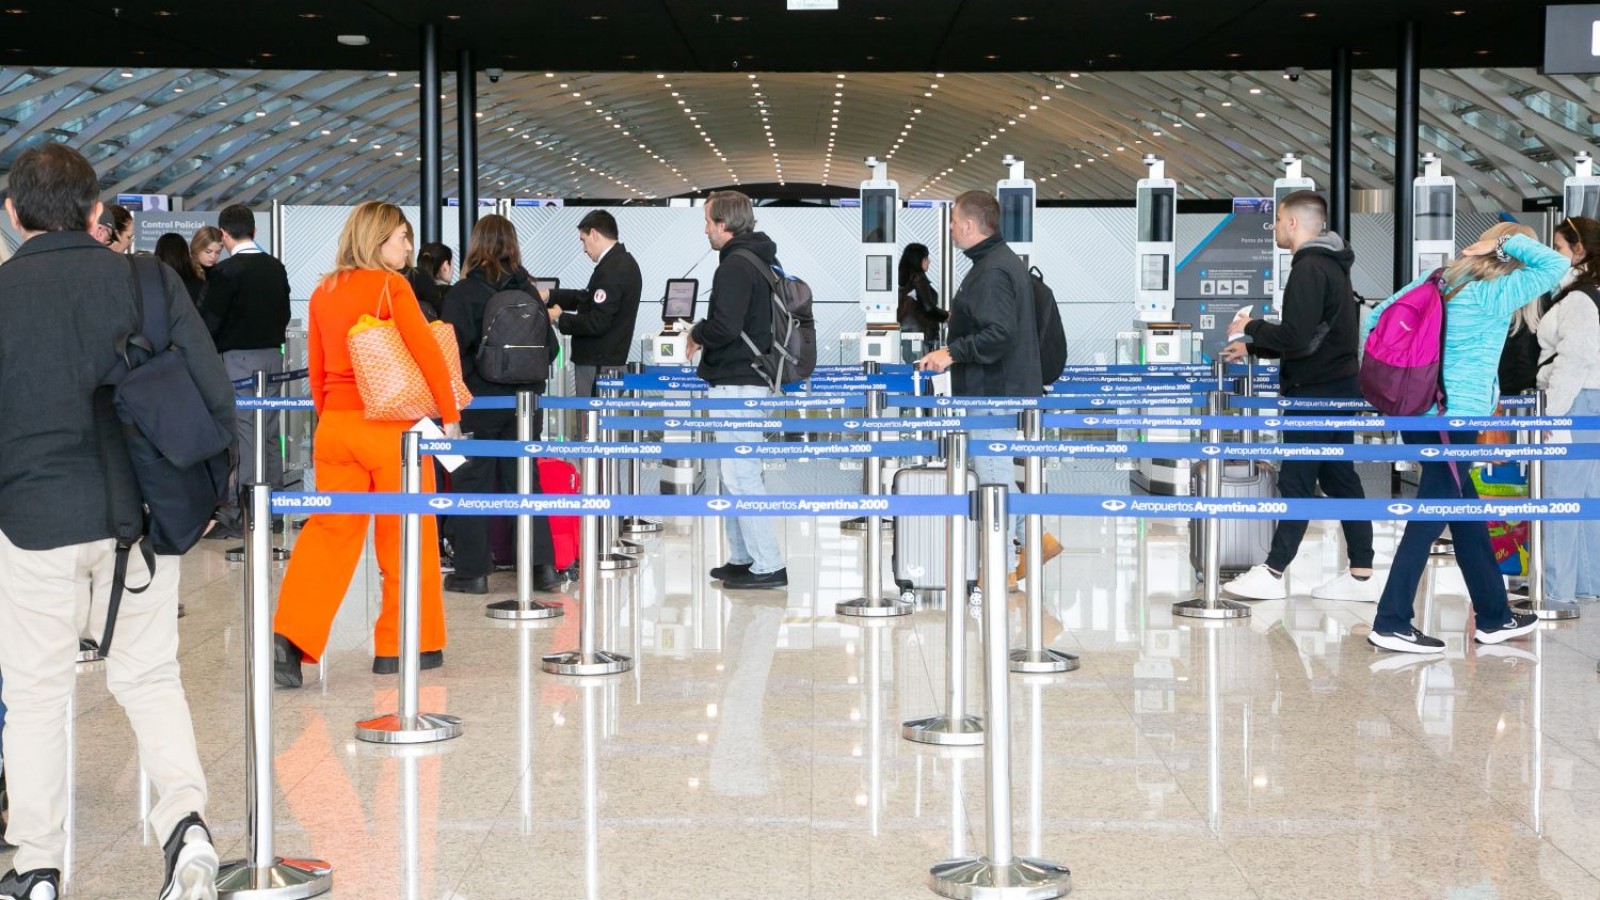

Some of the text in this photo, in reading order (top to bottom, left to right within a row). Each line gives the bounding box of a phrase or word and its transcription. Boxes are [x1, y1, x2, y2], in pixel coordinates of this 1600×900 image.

[141, 221, 206, 229] Control Policial
[262, 399, 297, 407] Argentina
[605, 400, 640, 408] Aeropuertos
[640, 400, 674, 408] Argentina
[760, 400, 794, 408] Aeropuertos
[794, 399, 828, 407] Argentina
[987, 399, 1021, 407] Argentina
[1329, 400, 1364, 408] Argentina
[683, 420, 782, 428] Aeropuertos Argentina 2000
[902, 420, 941, 428] Argentina
[942, 419, 960, 427] 2000
[1102, 418, 1202, 427] Aeropuertos Argentina 2000
[1283, 419, 1325, 427] Aeropuertos
[1325, 419, 1364, 428] Argentina
[1468, 418, 1573, 428] Aeropuertos Argentina 2000
[429, 442, 452, 450] 2000
[546, 445, 662, 455] Aeropuertos Argentina 2000
[756, 444, 872, 454] Aeropuertos Argentina 2000
[1010, 444, 1128, 454] Aeropuertos Argentina 2000
[1223, 446, 1344, 457] Aeropuertos Argentina 2000
[1443, 447, 1567, 457] Aeropuertos Argentina 2000
[302, 495, 332, 507] 2000
[457, 497, 610, 511] Aeropuertos Argentina 2000
[736, 499, 889, 512] Aeropuertos Argentina 2000
[1131, 500, 1288, 514] Aeropuertos Argentina 2000
[1417, 502, 1581, 516] Aeropuertos Argentina 2000
